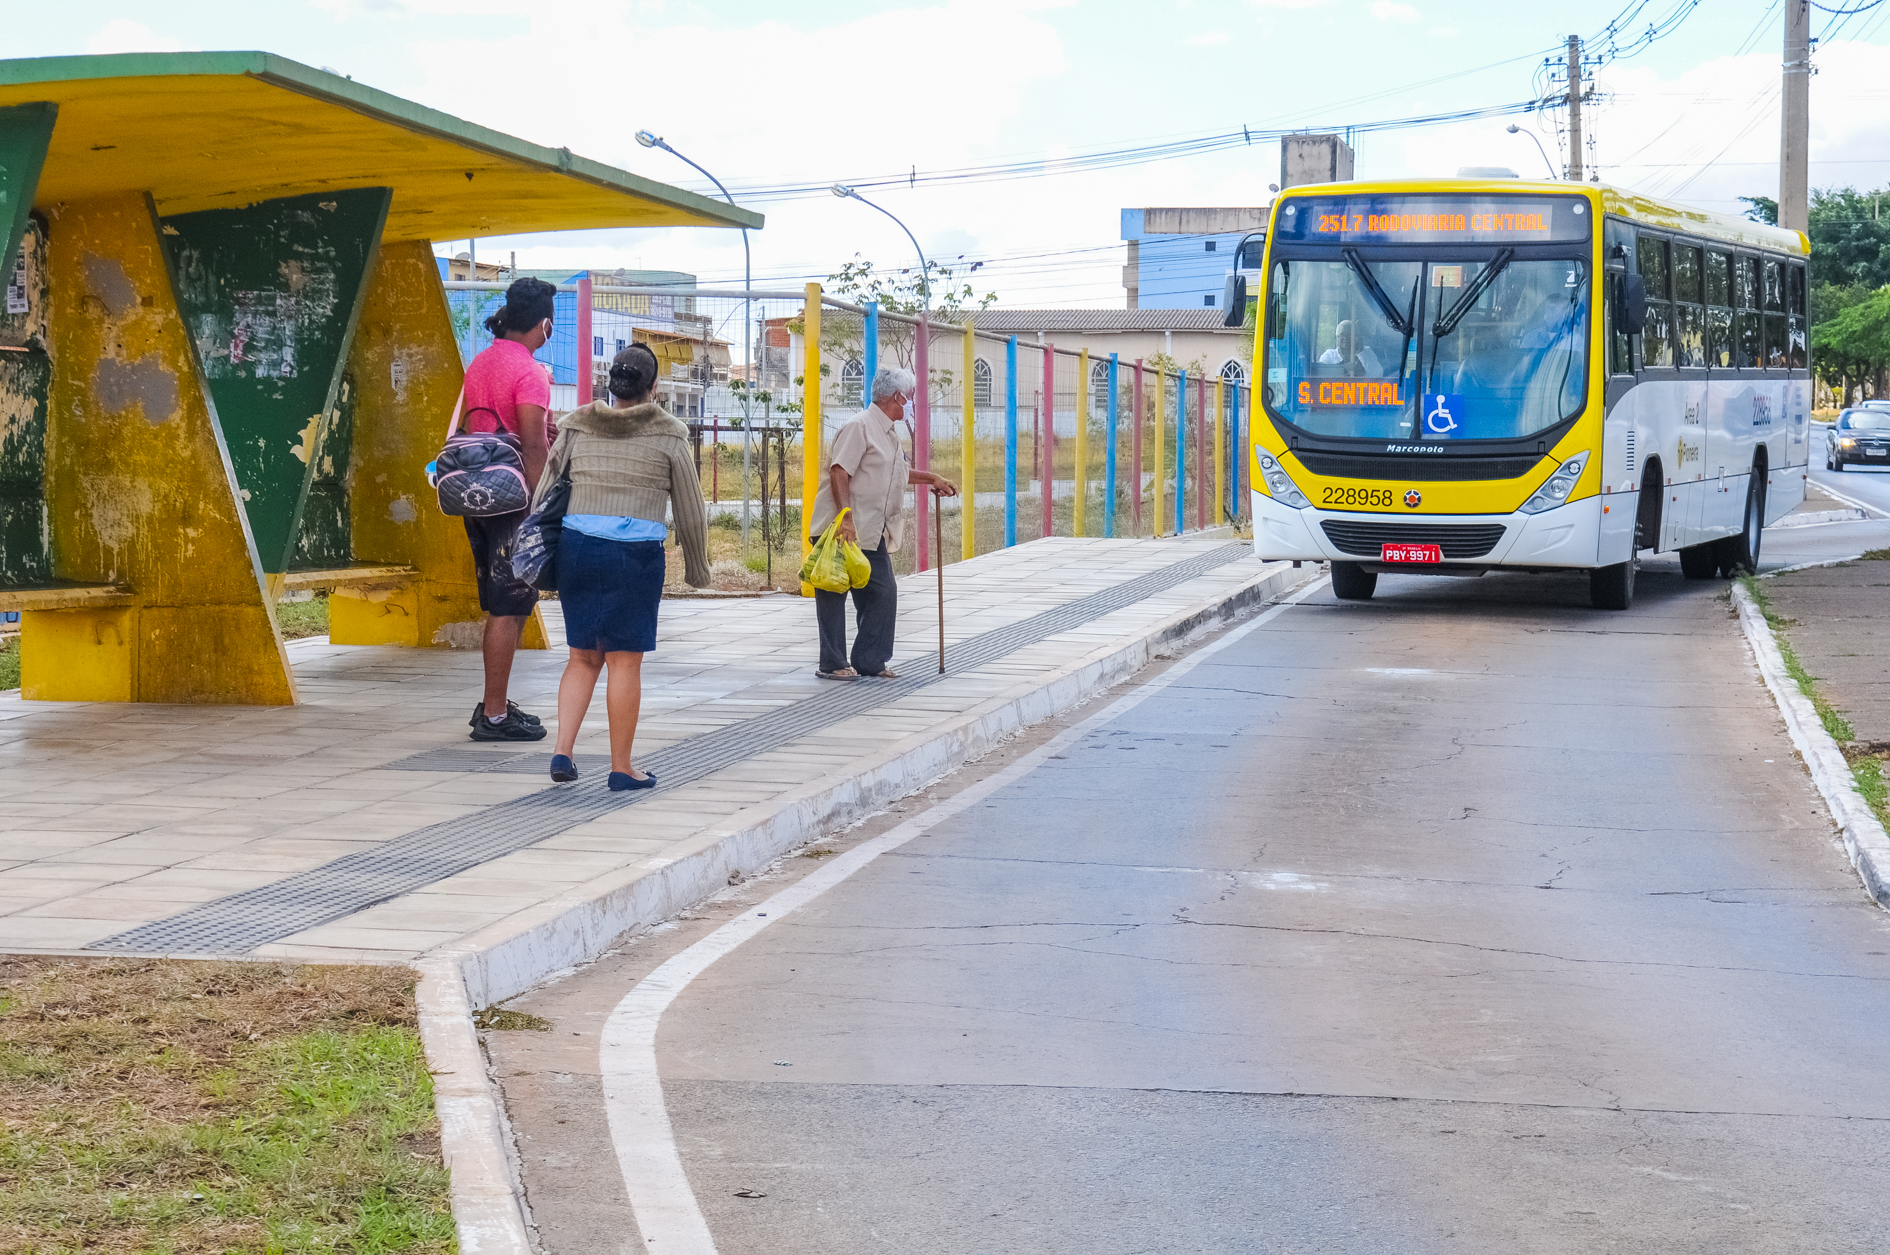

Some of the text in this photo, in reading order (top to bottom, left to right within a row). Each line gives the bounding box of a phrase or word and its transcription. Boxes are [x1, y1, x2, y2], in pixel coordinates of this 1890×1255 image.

[1318, 213, 1548, 232] 251.7 RODOVIARIA CENTRAL
[1298, 381, 1405, 406] S. CENTRAL
[1386, 444, 1444, 454] Marcopolo
[1322, 487, 1393, 506] 228958
